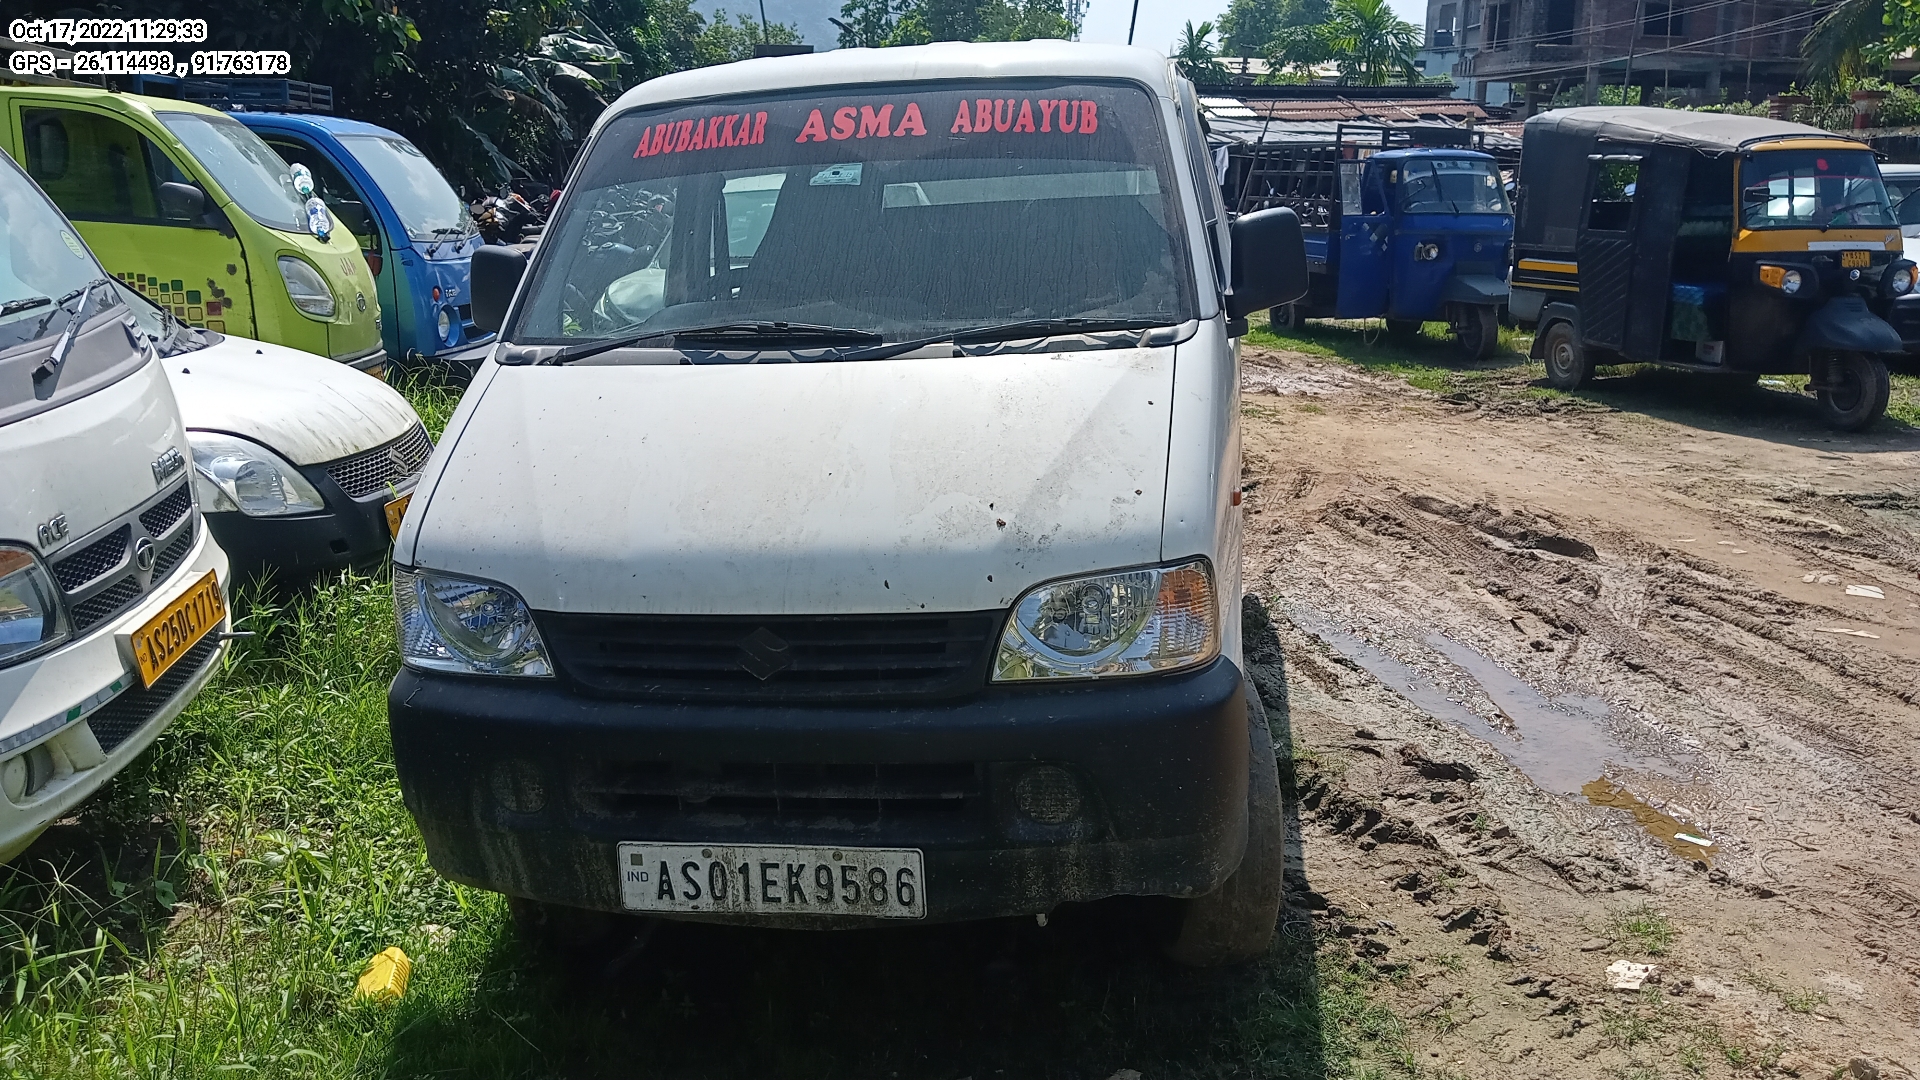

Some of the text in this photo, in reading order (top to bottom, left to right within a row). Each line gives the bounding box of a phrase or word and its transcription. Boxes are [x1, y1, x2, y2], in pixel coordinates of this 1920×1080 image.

[632, 98, 1098, 159] ABUBAKKAR ASMA ABUAYUB
[38, 512, 70, 549] ACE
[146, 579, 221, 675] AS25DC1719
[626, 870, 649, 883] IND
[656, 860, 917, 907] AS01EK9586
